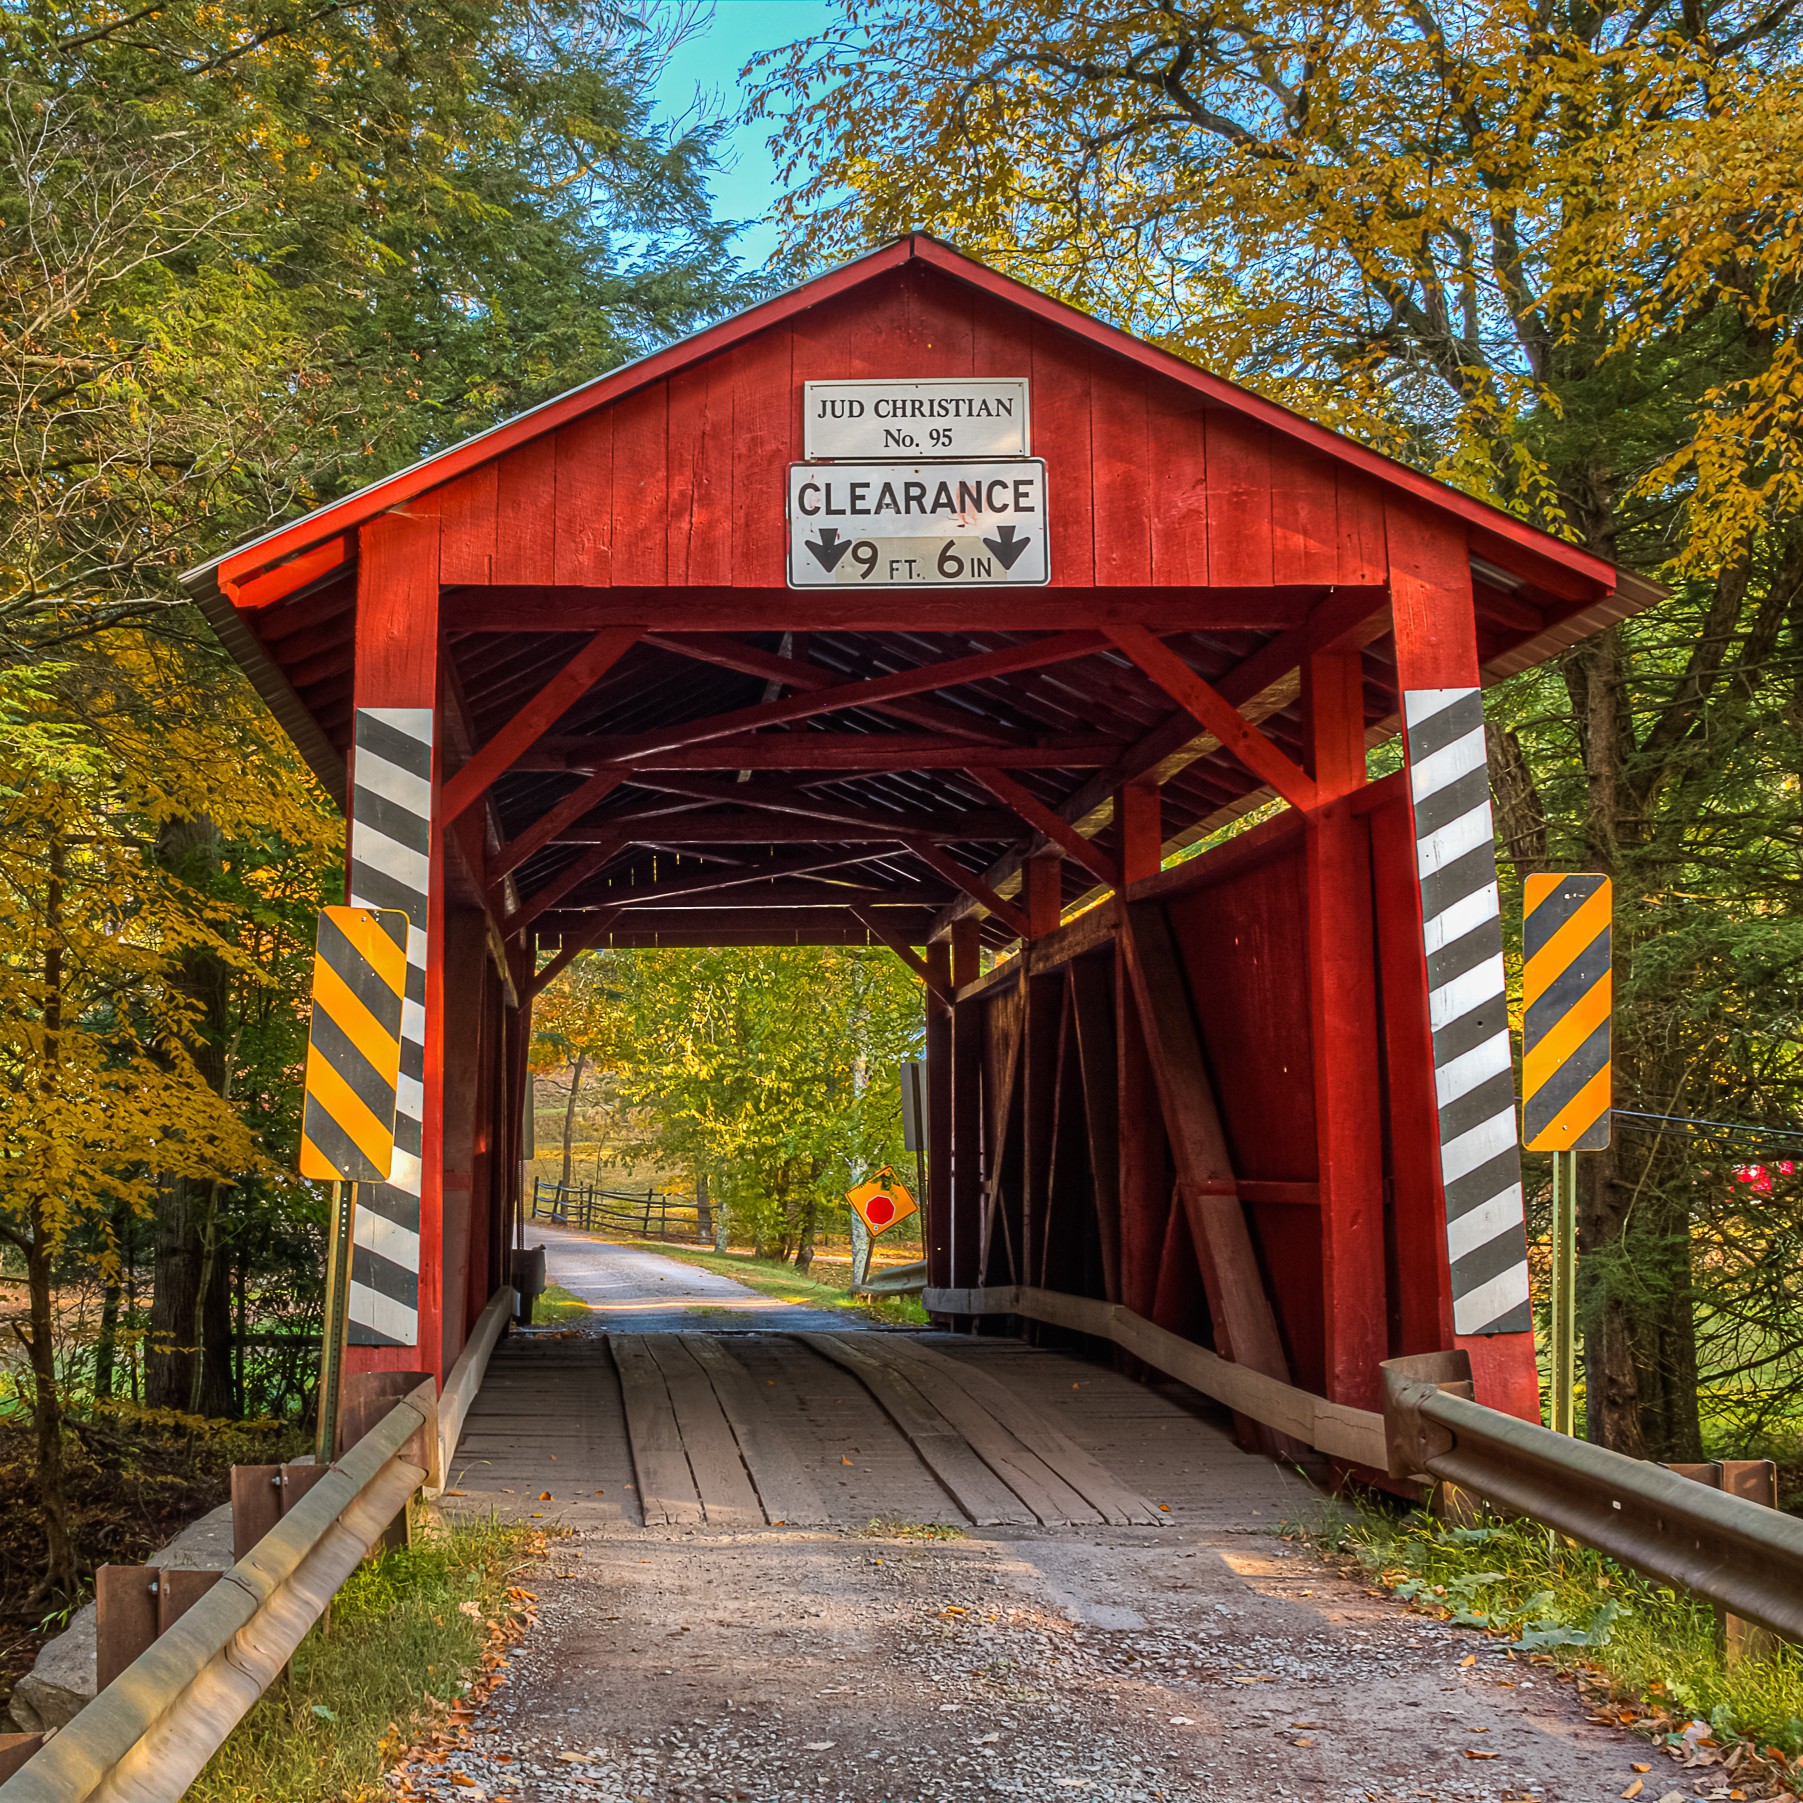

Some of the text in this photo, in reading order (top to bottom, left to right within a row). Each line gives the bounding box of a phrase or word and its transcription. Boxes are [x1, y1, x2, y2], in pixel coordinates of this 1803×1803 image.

[817, 398, 1014, 418] JUD CHRISTIAN
[883, 428, 953, 447] No. 95
[798, 479, 1035, 516] CLEARANCE
[851, 540, 878, 580] 9
[937, 539, 965, 579] 6
[971, 557, 992, 578] IN
